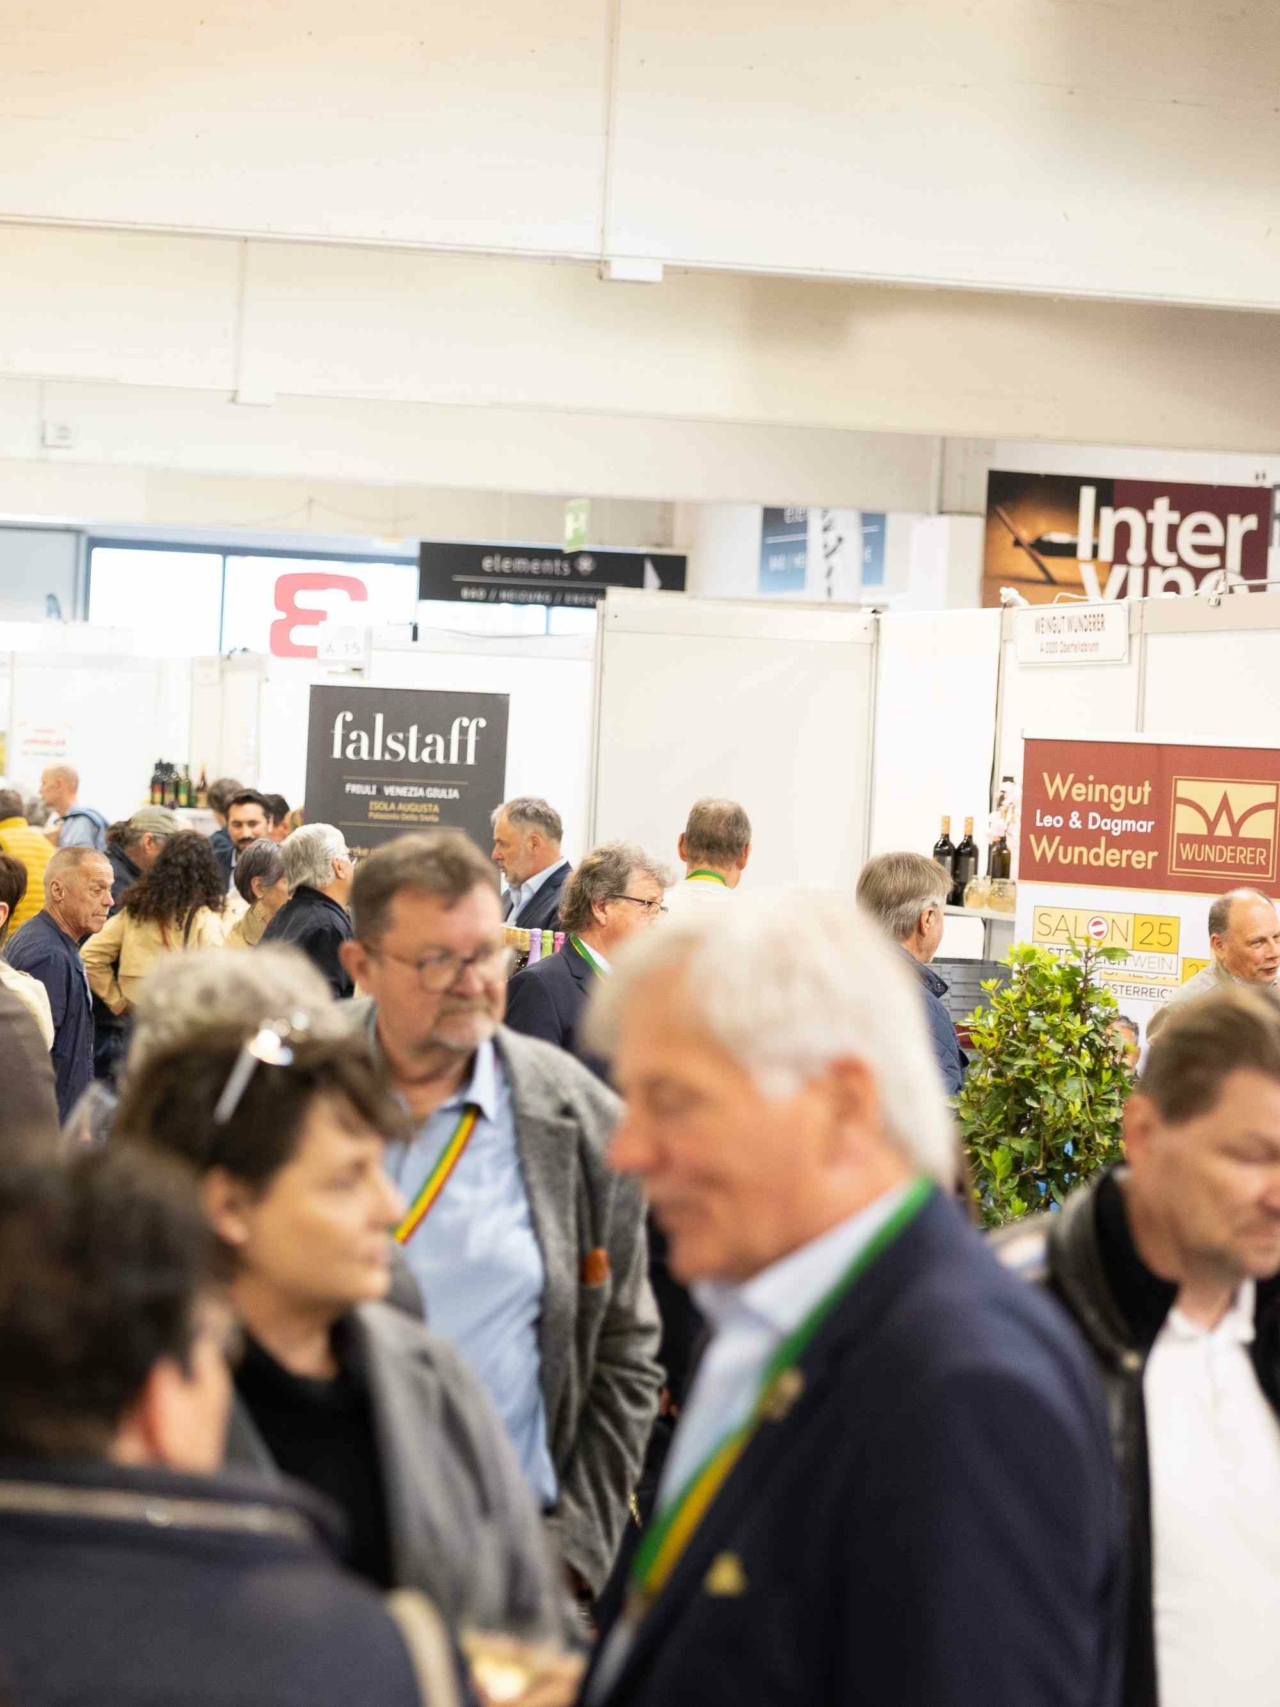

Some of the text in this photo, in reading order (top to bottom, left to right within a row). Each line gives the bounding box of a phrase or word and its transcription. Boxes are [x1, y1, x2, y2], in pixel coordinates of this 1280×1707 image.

[1076, 484, 1259, 575] Inter
[330, 710, 488, 766] falstaff
[383, 784, 425, 799] VENEZIA
[1041, 771, 1152, 813] Weingut
[1035, 809, 1156, 837] Leo & Dagmar
[1028, 833, 1159, 870] Wunderer
[1179, 842, 1267, 866] WUNDERER
[1138, 920, 1173, 947] 25
[1132, 953, 1173, 971] WEIN
[1101, 982, 1174, 999] STERREIC
